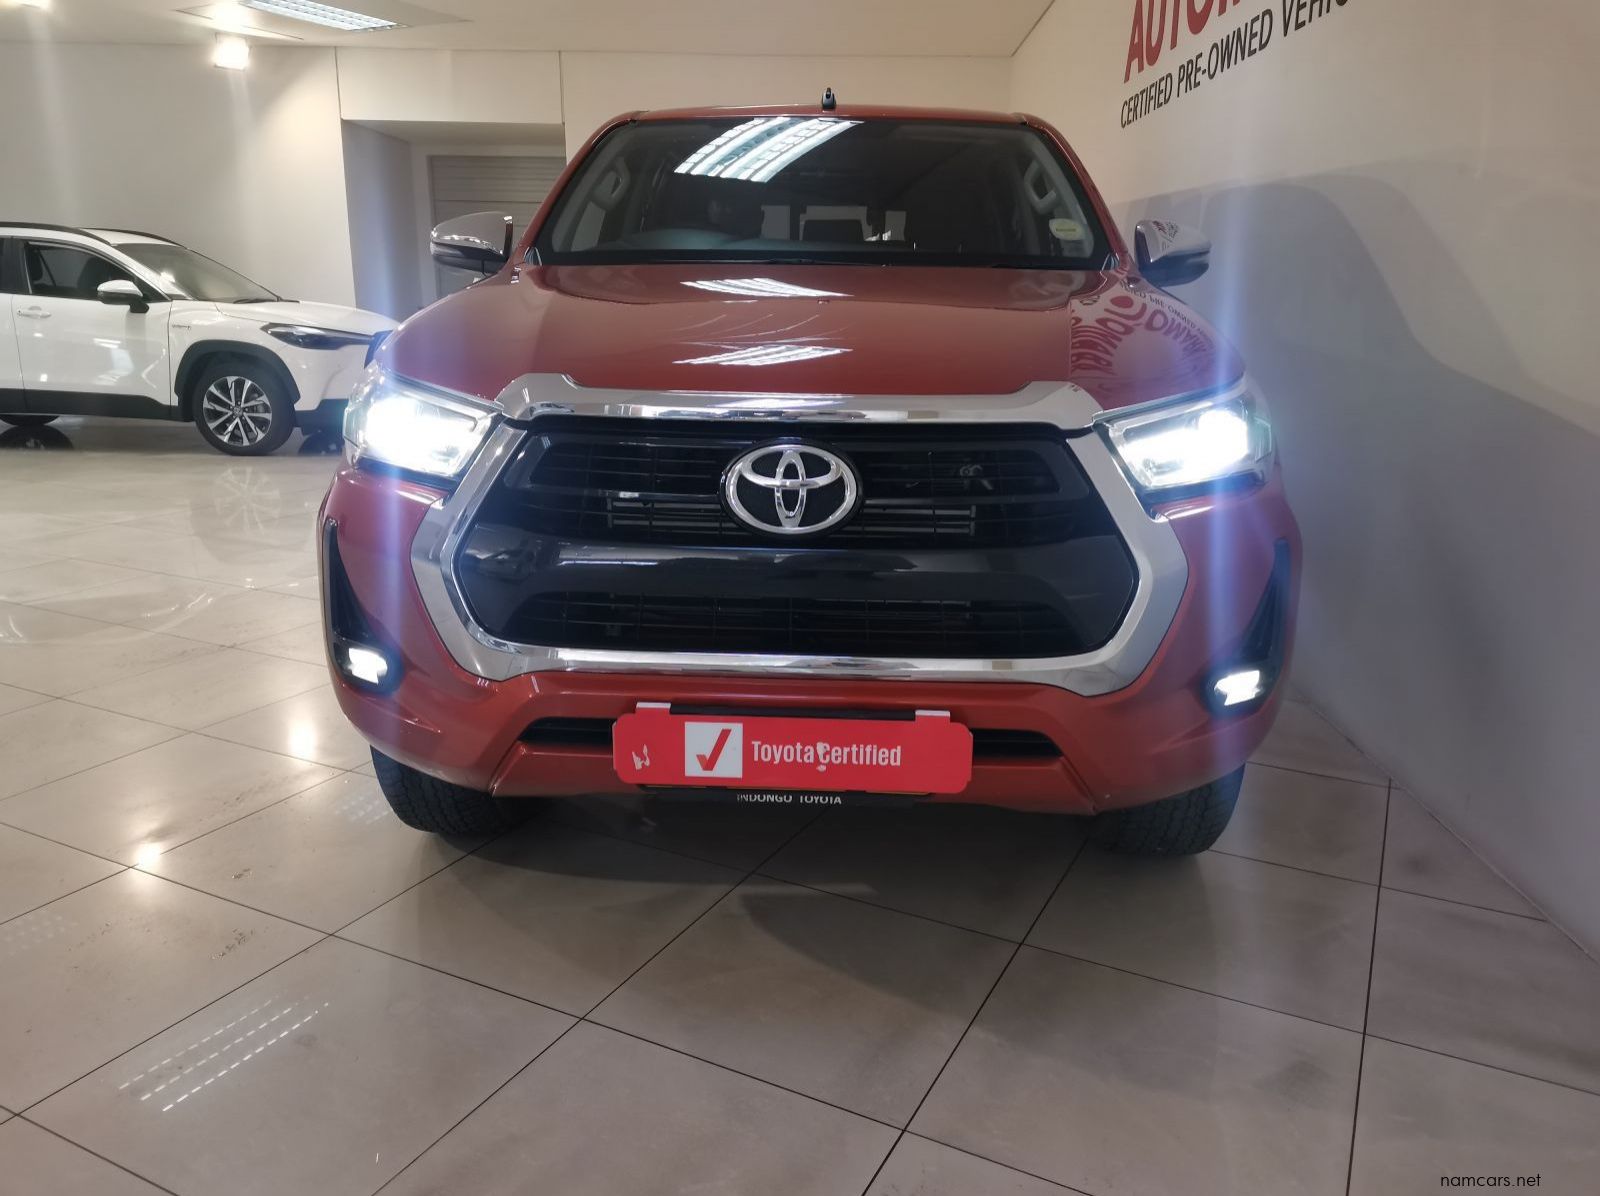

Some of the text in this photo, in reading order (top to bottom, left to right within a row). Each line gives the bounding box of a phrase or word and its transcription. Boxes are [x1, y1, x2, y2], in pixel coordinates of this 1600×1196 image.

[1120, 0, 1348, 129] CERTIFIED PRE-OWNED VEH
[751, 741, 902, 766] Toyota Certified
[799, 795, 842, 805] TOYOTA
